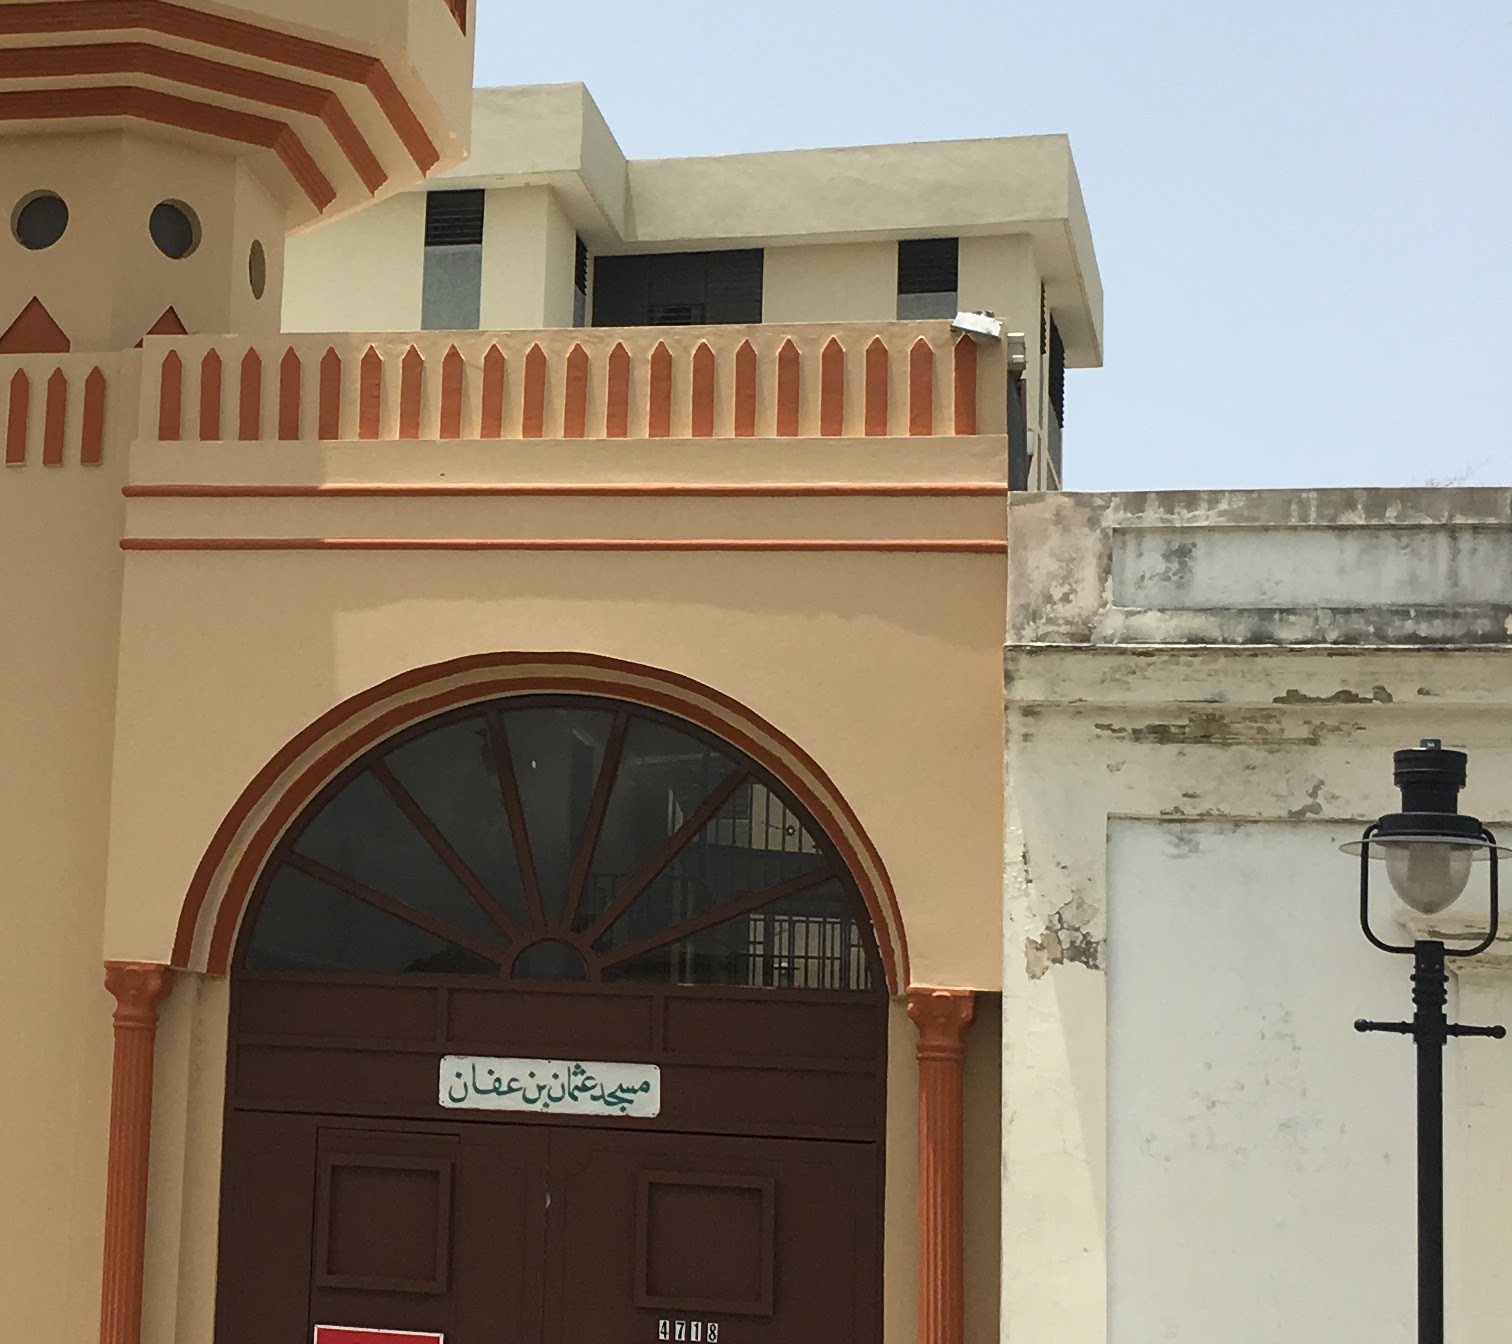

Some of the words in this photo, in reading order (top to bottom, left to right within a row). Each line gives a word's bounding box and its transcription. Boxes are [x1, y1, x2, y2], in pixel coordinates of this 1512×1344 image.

[448, 1062, 523, 1103] عفان
[522, 1070, 549, 1108] بن
[546, 1063, 599, 1103] عثمان
[590, 1080, 651, 1113] مسجد
[659, 1320, 718, 1343] 4718
